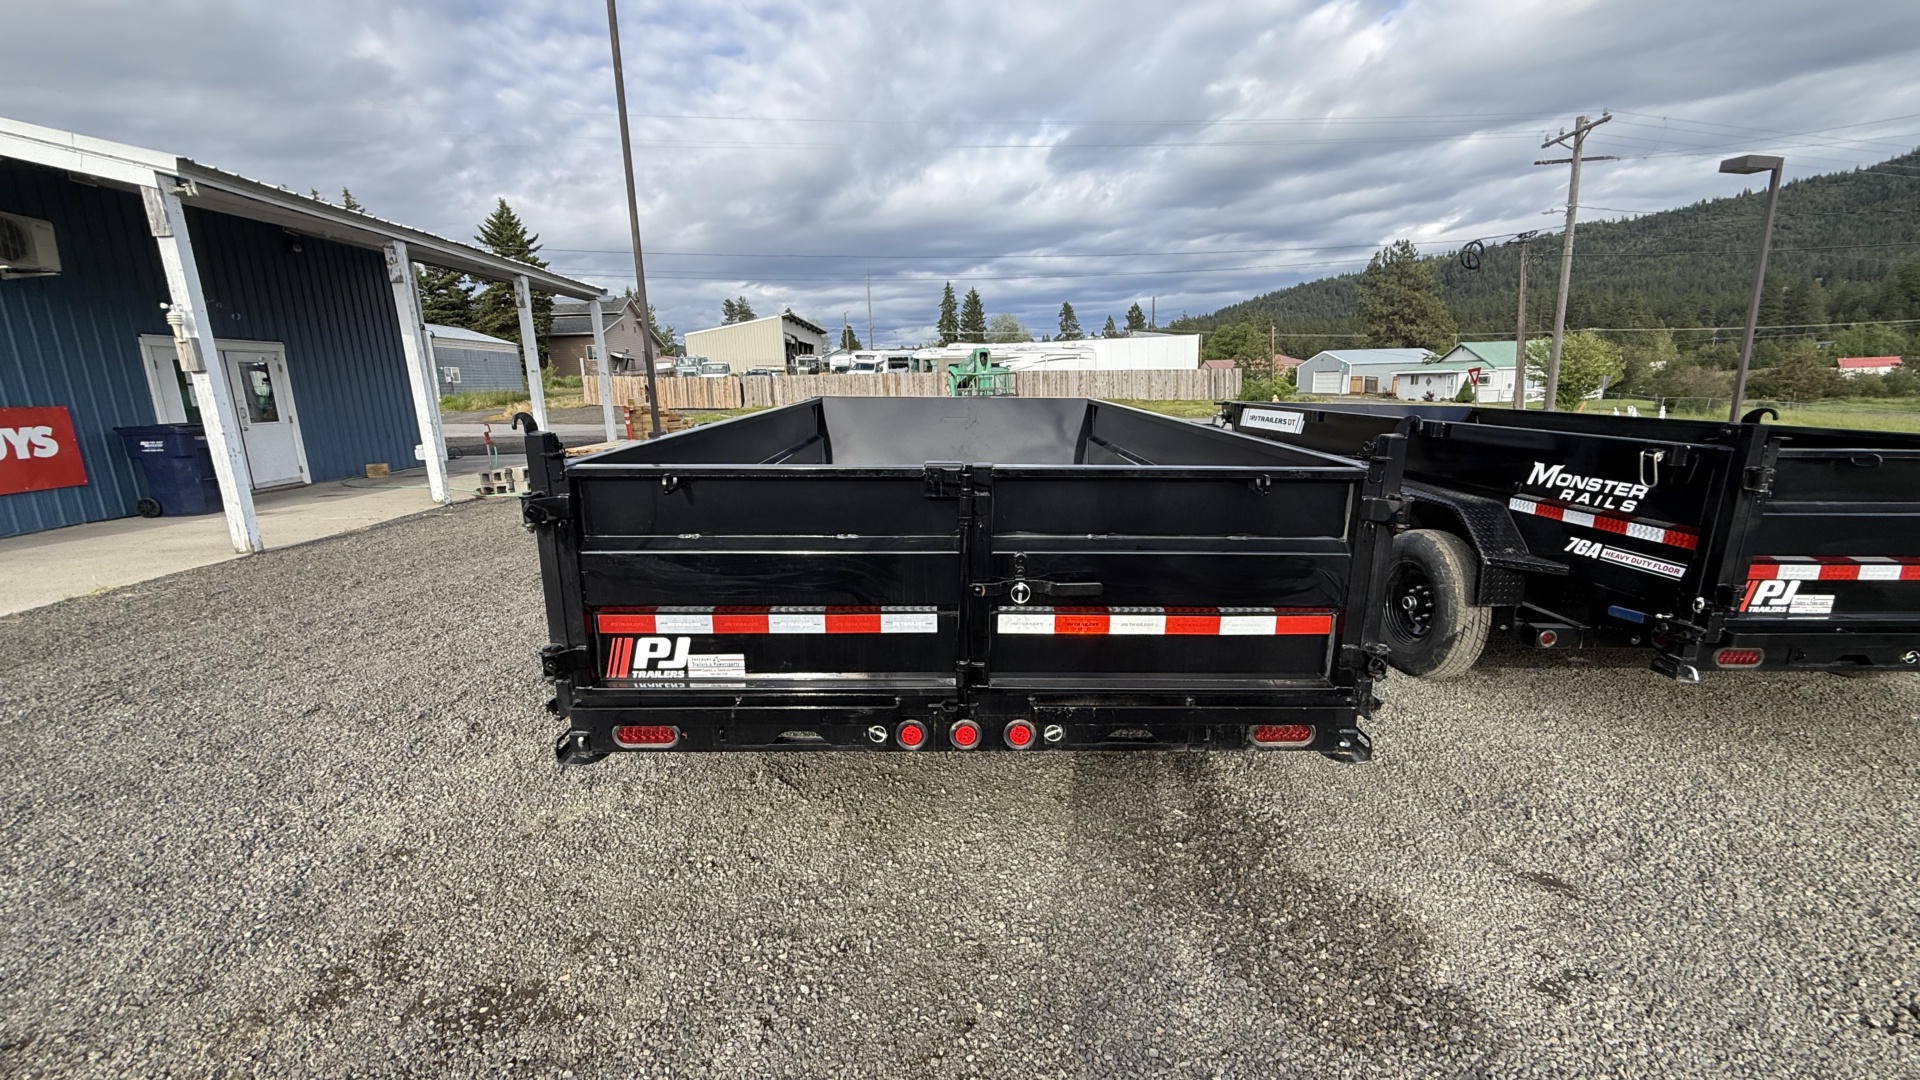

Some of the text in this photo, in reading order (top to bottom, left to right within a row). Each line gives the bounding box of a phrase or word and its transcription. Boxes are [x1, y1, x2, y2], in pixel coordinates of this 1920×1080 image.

[1527, 461, 1649, 500] MONSTER
[1559, 489, 1638, 513] RAILS
[1564, 537, 1603, 559] 7GA
[1604, 550, 1681, 575] HEAVY DUTY FLOOR
[1751, 580, 1801, 606] PJ
[633, 637, 691, 669] PJ
[632, 670, 685, 679] TRAILERS
